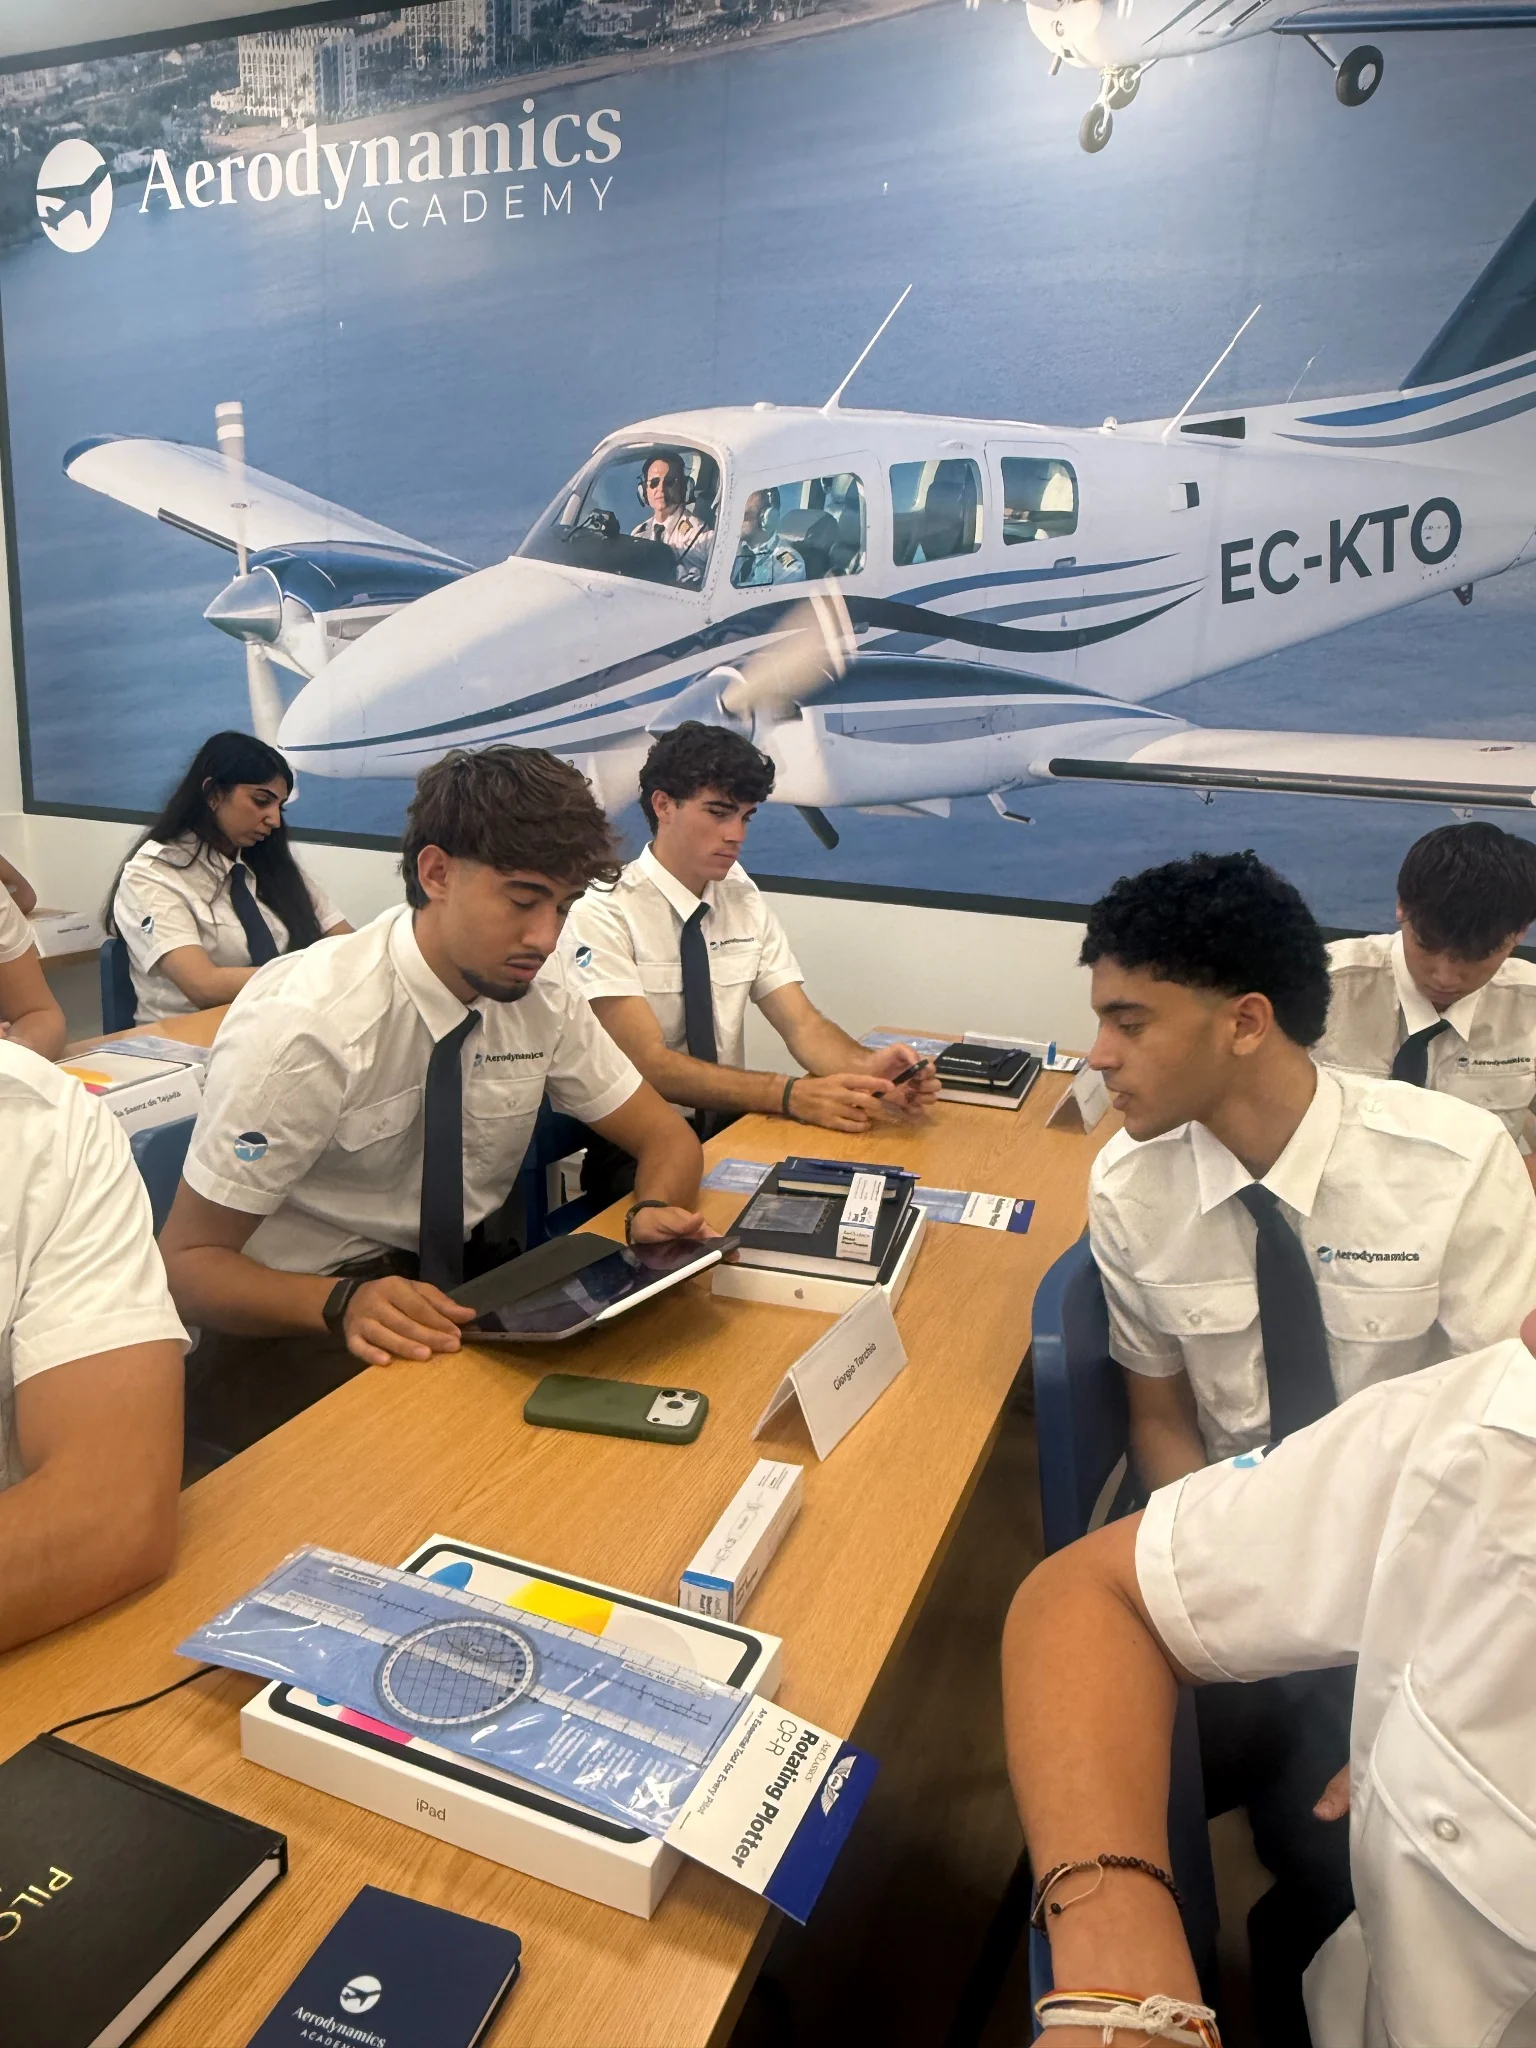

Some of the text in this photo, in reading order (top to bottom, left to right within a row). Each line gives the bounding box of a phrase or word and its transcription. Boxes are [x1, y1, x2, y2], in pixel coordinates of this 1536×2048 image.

[138, 98, 622, 214] Aerodynamics
[351, 176, 614, 234] ACADEMY
[1221, 496, 1462, 605] EC-KTO
[1335, 1249, 1420, 1263] Aerodynamics
[833, 1364, 856, 1391] Giorgio
[765, 1719, 798, 1757] CP-R
[707, 1773, 728, 1797] Every
[731, 1729, 820, 1869] Rotating Plotter
[416, 1797, 446, 1822] iPad
[292, 2006, 387, 2048] Aerodynamics
